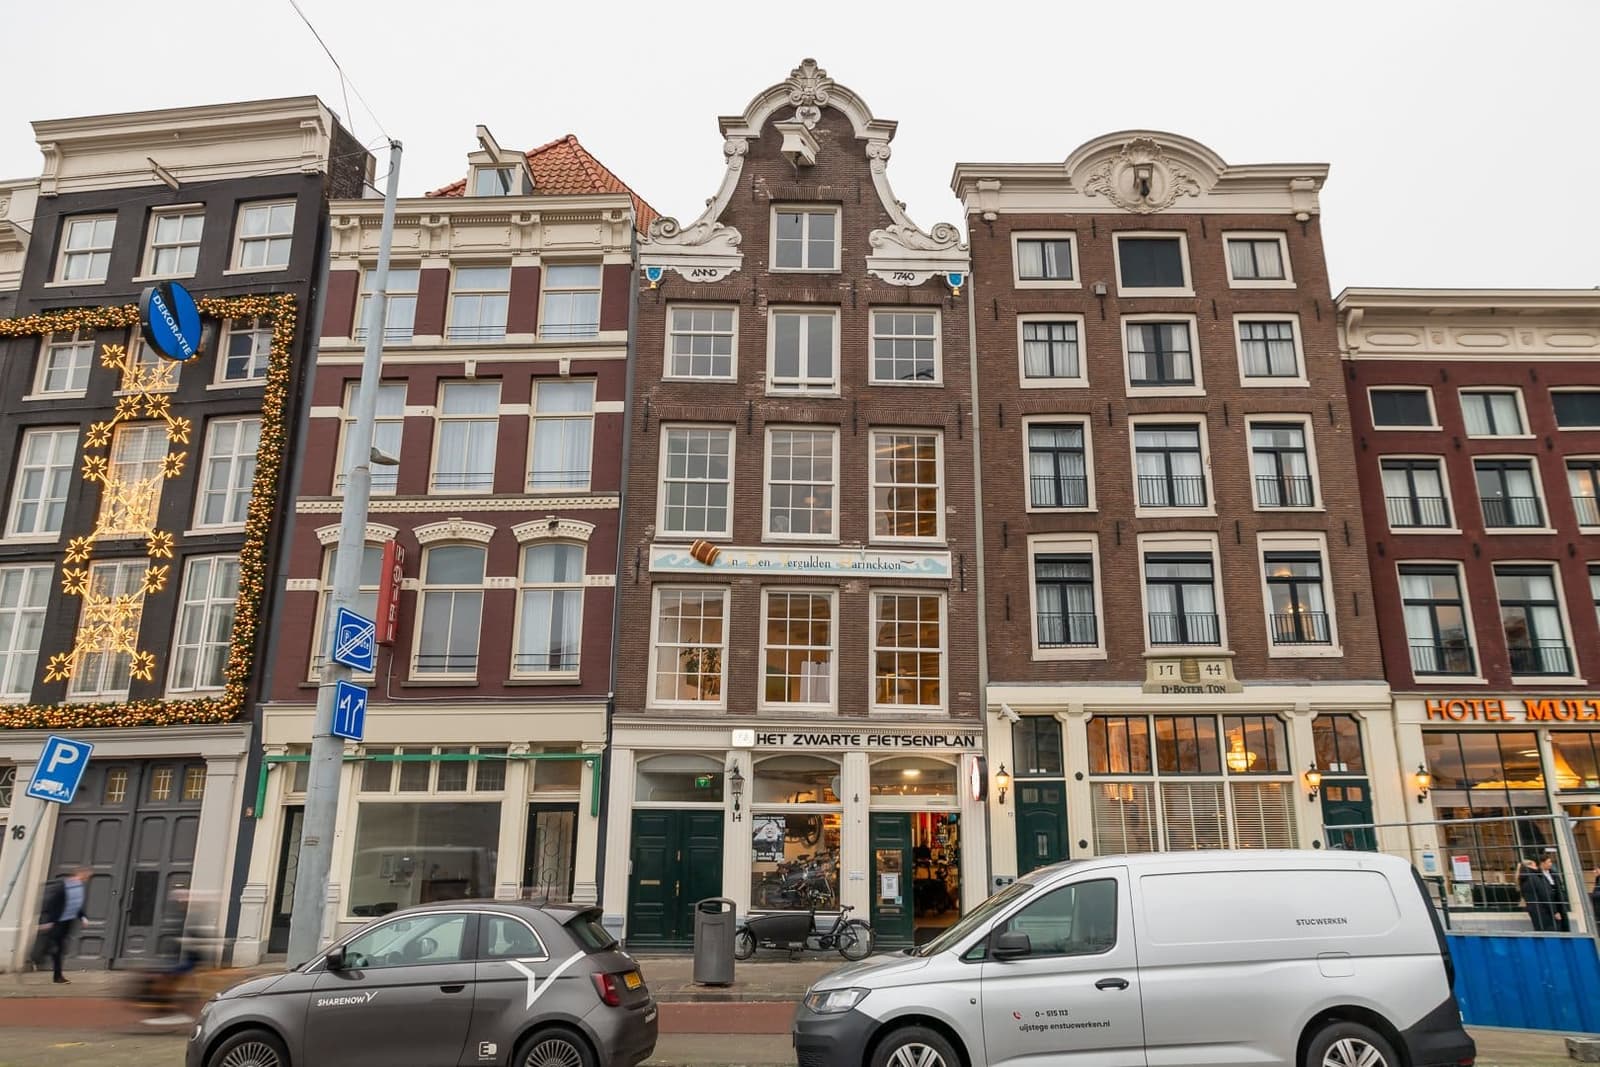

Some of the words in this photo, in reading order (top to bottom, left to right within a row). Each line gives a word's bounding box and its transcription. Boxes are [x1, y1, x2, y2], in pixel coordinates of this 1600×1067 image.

[691, 269, 718, 277] ANNO
[892, 272, 916, 280] 1740
[153, 295, 192, 356] DEKORATIE
[1159, 665, 1174, 675] 17
[1206, 664, 1221, 675] 44
[1426, 698, 1515, 721] HOTEL
[756, 733, 787, 745] HET
[793, 734, 861, 746] ZWARTE
[867, 734, 976, 747] FIETSENPLAN
[46, 742, 80, 773] P
[732, 812, 742, 822] 14
[11, 825, 26, 840] 16
[1295, 918, 1348, 926] STUCWERKEN
[317, 995, 366, 1006] SHARENOW
